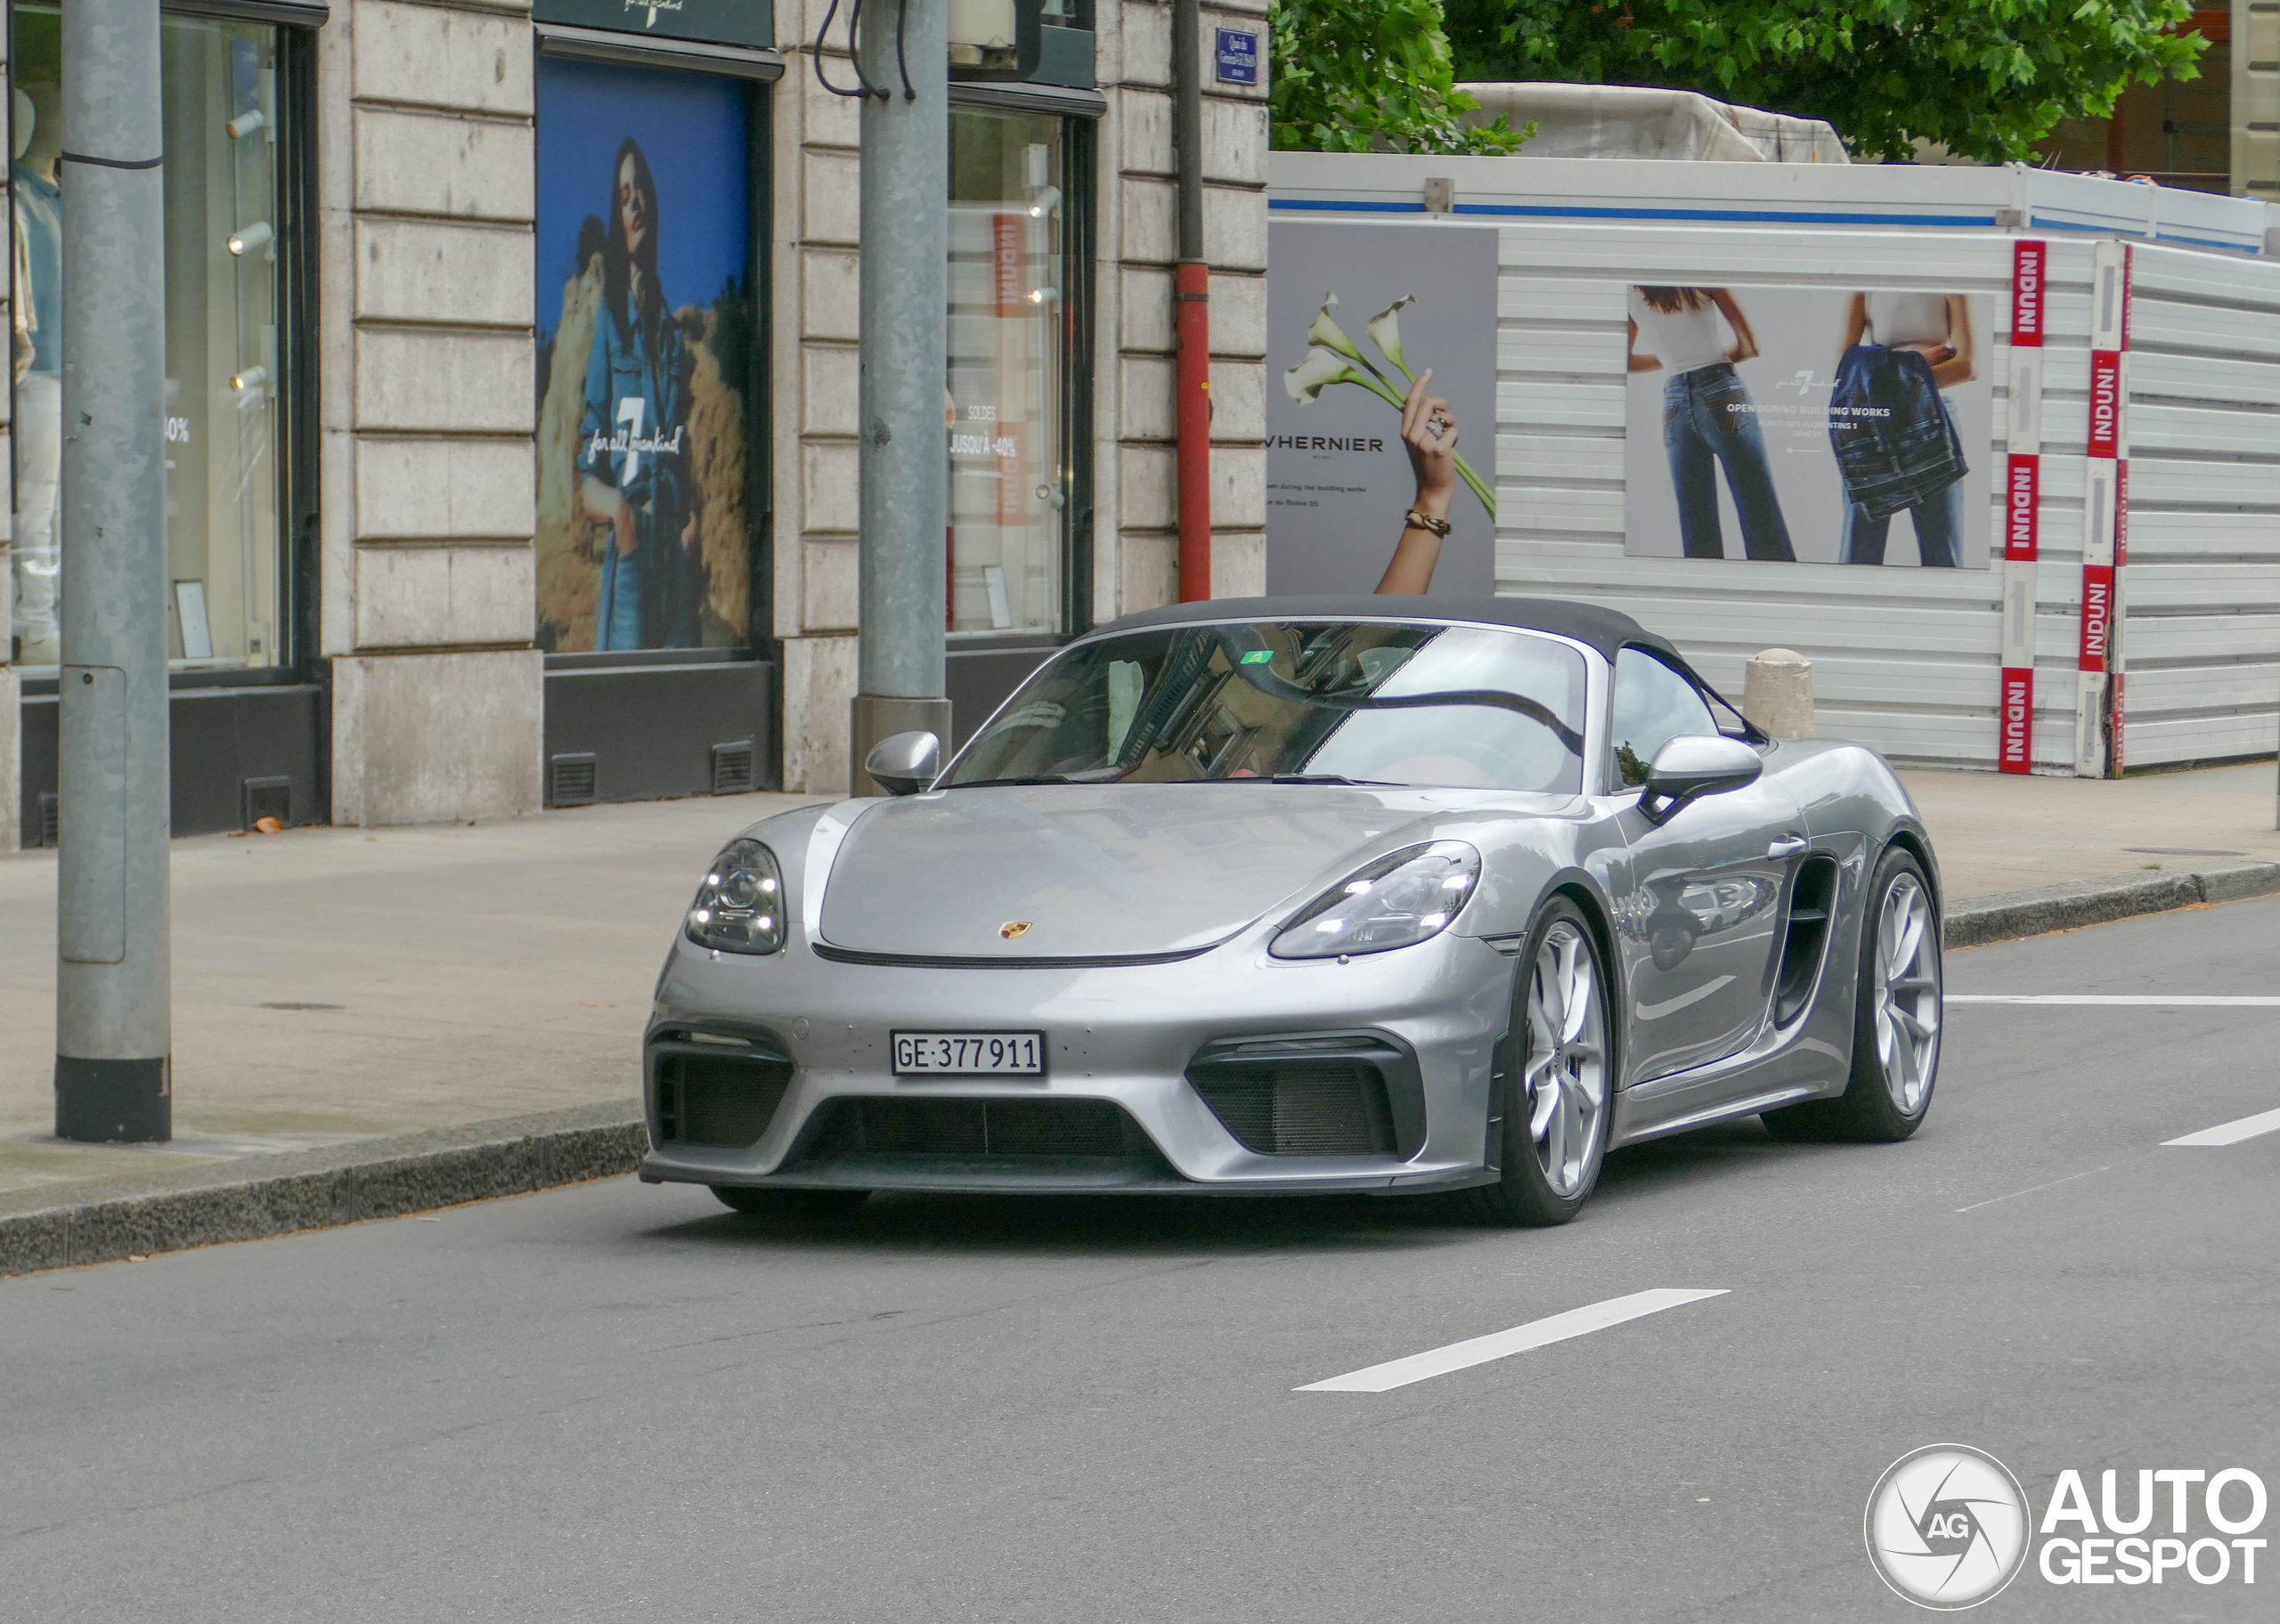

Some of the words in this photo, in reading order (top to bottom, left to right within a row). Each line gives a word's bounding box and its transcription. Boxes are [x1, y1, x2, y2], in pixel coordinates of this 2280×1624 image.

[2018, 251, 2038, 332] INDUNI
[968, 405, 996, 420] SOLDES
[1726, 403, 1755, 413] OPEN
[1758, 404, 1796, 414] DURING
[1799, 405, 1849, 415] BUILDING
[1852, 407, 1891, 417] WORKS
[2094, 368, 2114, 442] INDUNI
[588, 428, 608, 465] for
[610, 429, 628, 451] all
[616, 397, 646, 487] 7
[1263, 435, 1384, 451] VHERNIER
[1280, 483, 1302, 491] during
[1317, 484, 1345, 492] building
[2012, 467, 2032, 548] INDUNI
[2086, 583, 2106, 655] INDUNI
[2007, 681, 2026, 762] INDUNI
